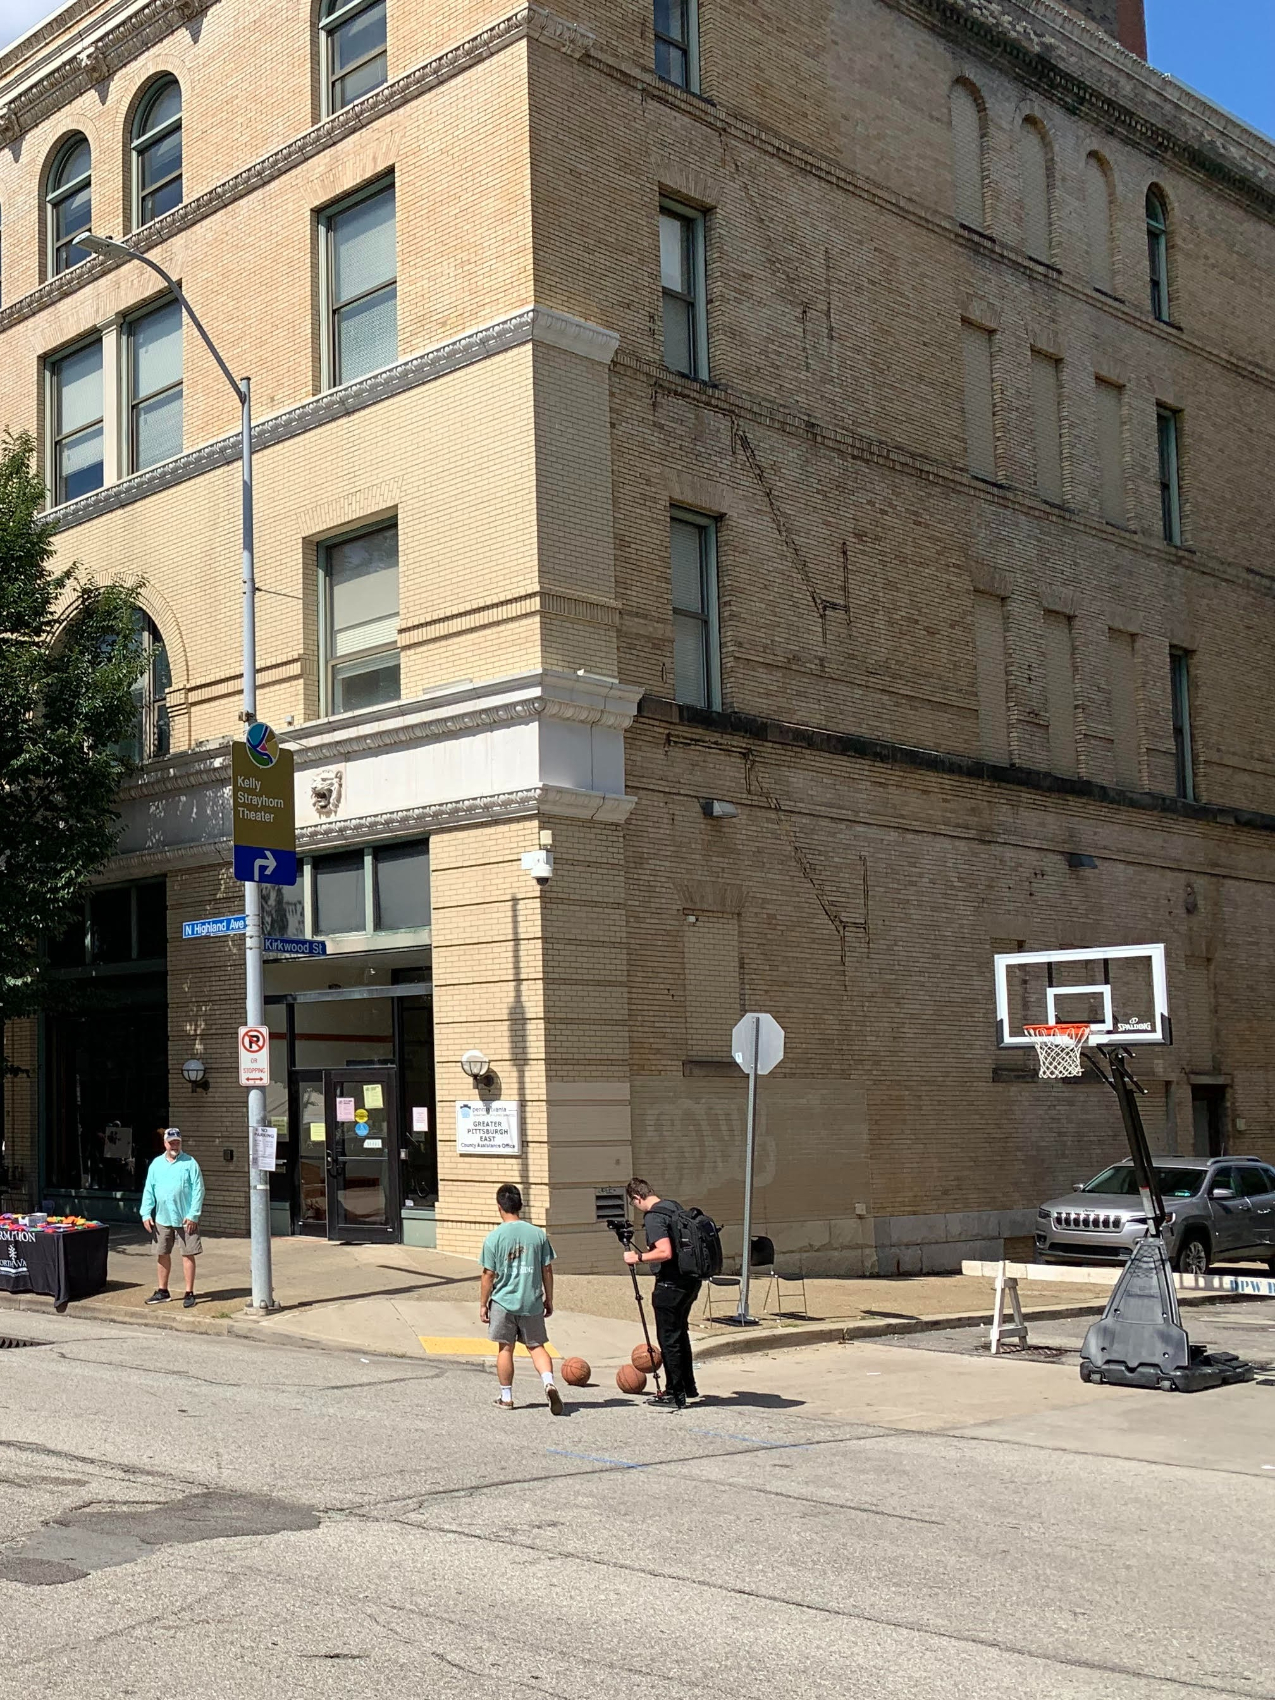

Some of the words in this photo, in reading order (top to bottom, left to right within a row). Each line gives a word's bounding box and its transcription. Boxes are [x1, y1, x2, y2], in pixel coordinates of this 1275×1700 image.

[237, 776, 262, 792] Kelly
[237, 791, 284, 808] Strayhorn
[237, 807, 275, 823] Theater
[185, 925, 192, 936] N
[194, 921, 227, 936] Highland
[229, 918, 245, 930] Ave
[265, 939, 310, 953] Kirkwood
[312, 943, 323, 954] St
[1117, 1022, 1152, 1032] SPALDING
[1230, 1280, 1262, 1293] DPW
